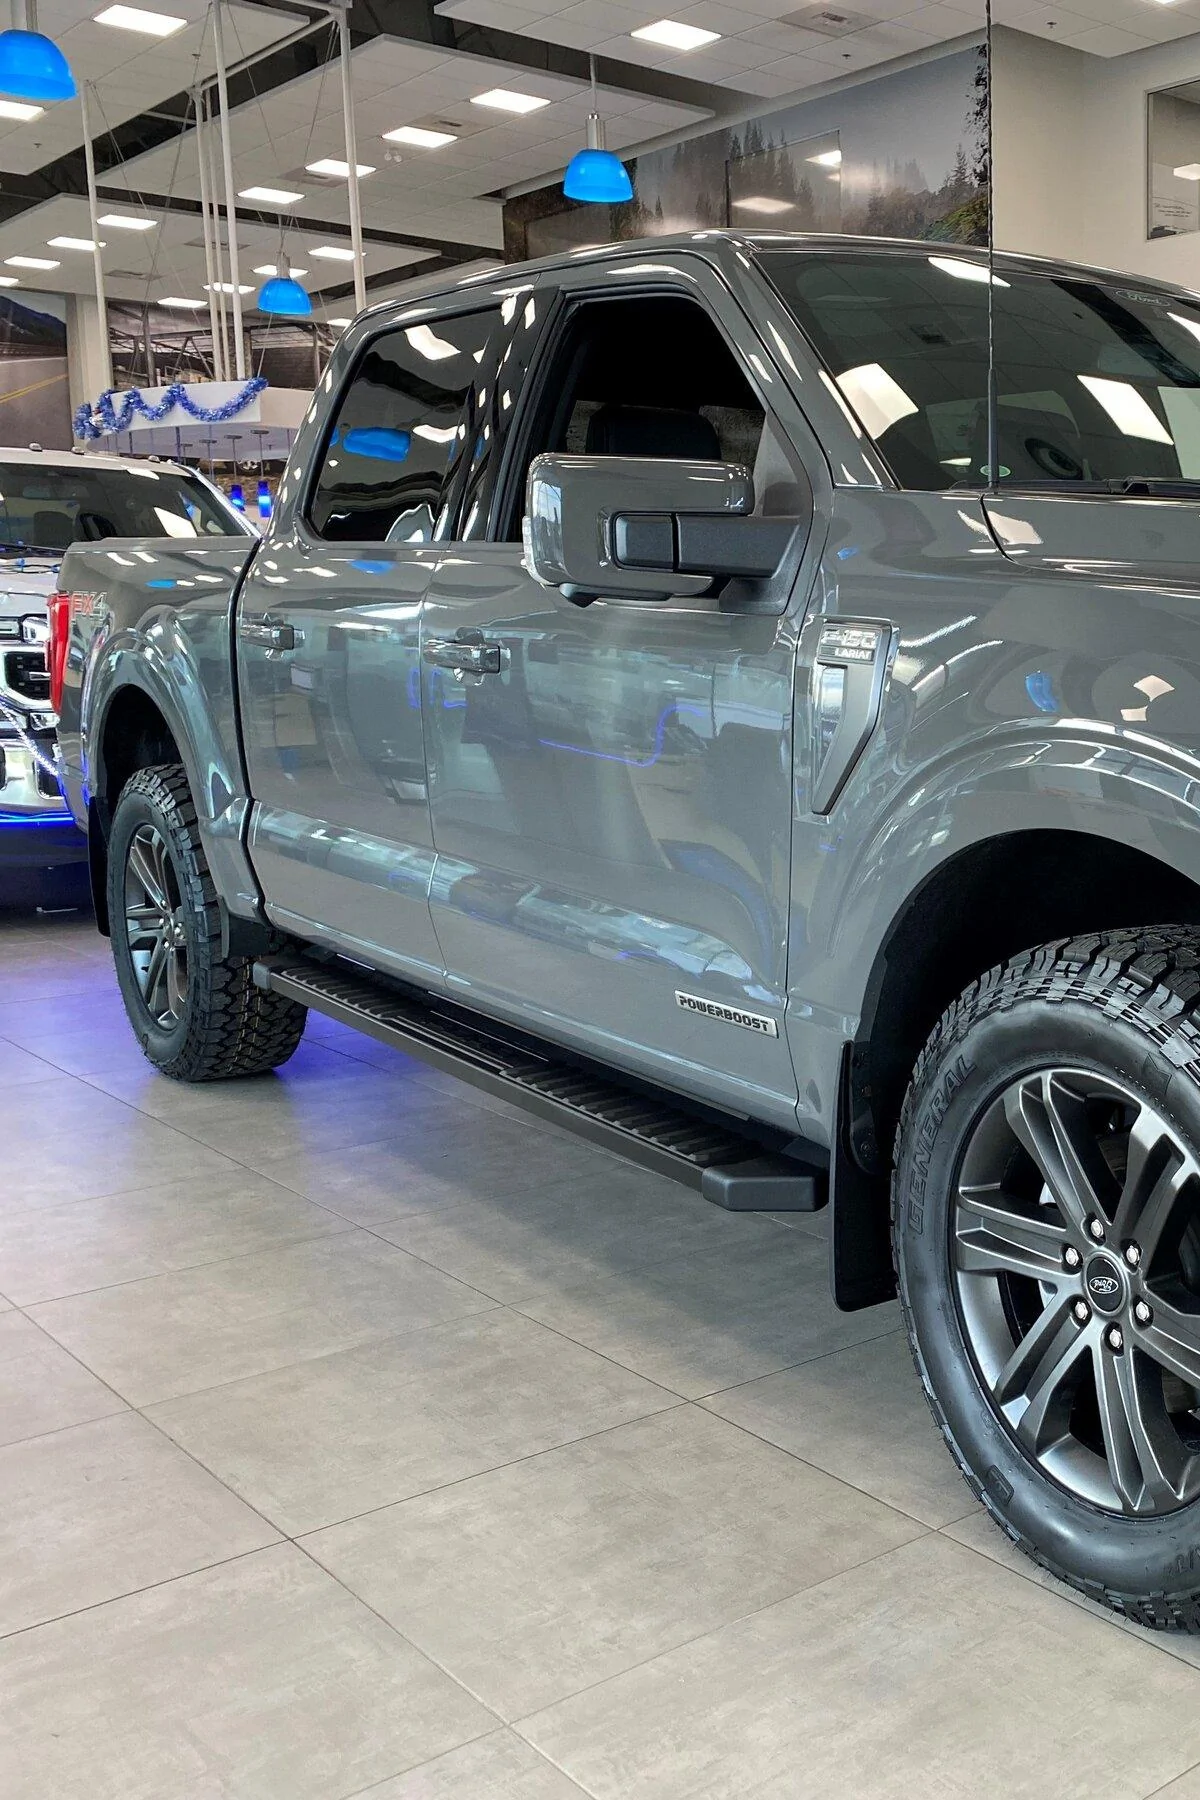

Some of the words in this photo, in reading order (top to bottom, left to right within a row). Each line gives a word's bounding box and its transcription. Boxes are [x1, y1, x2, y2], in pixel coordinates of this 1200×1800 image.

[70, 591, 108, 623] FX4
[834, 648, 873, 661] LARIAT
[678, 995, 769, 1032] POWERBOOST
[908, 1053, 977, 1236] GENERAL
